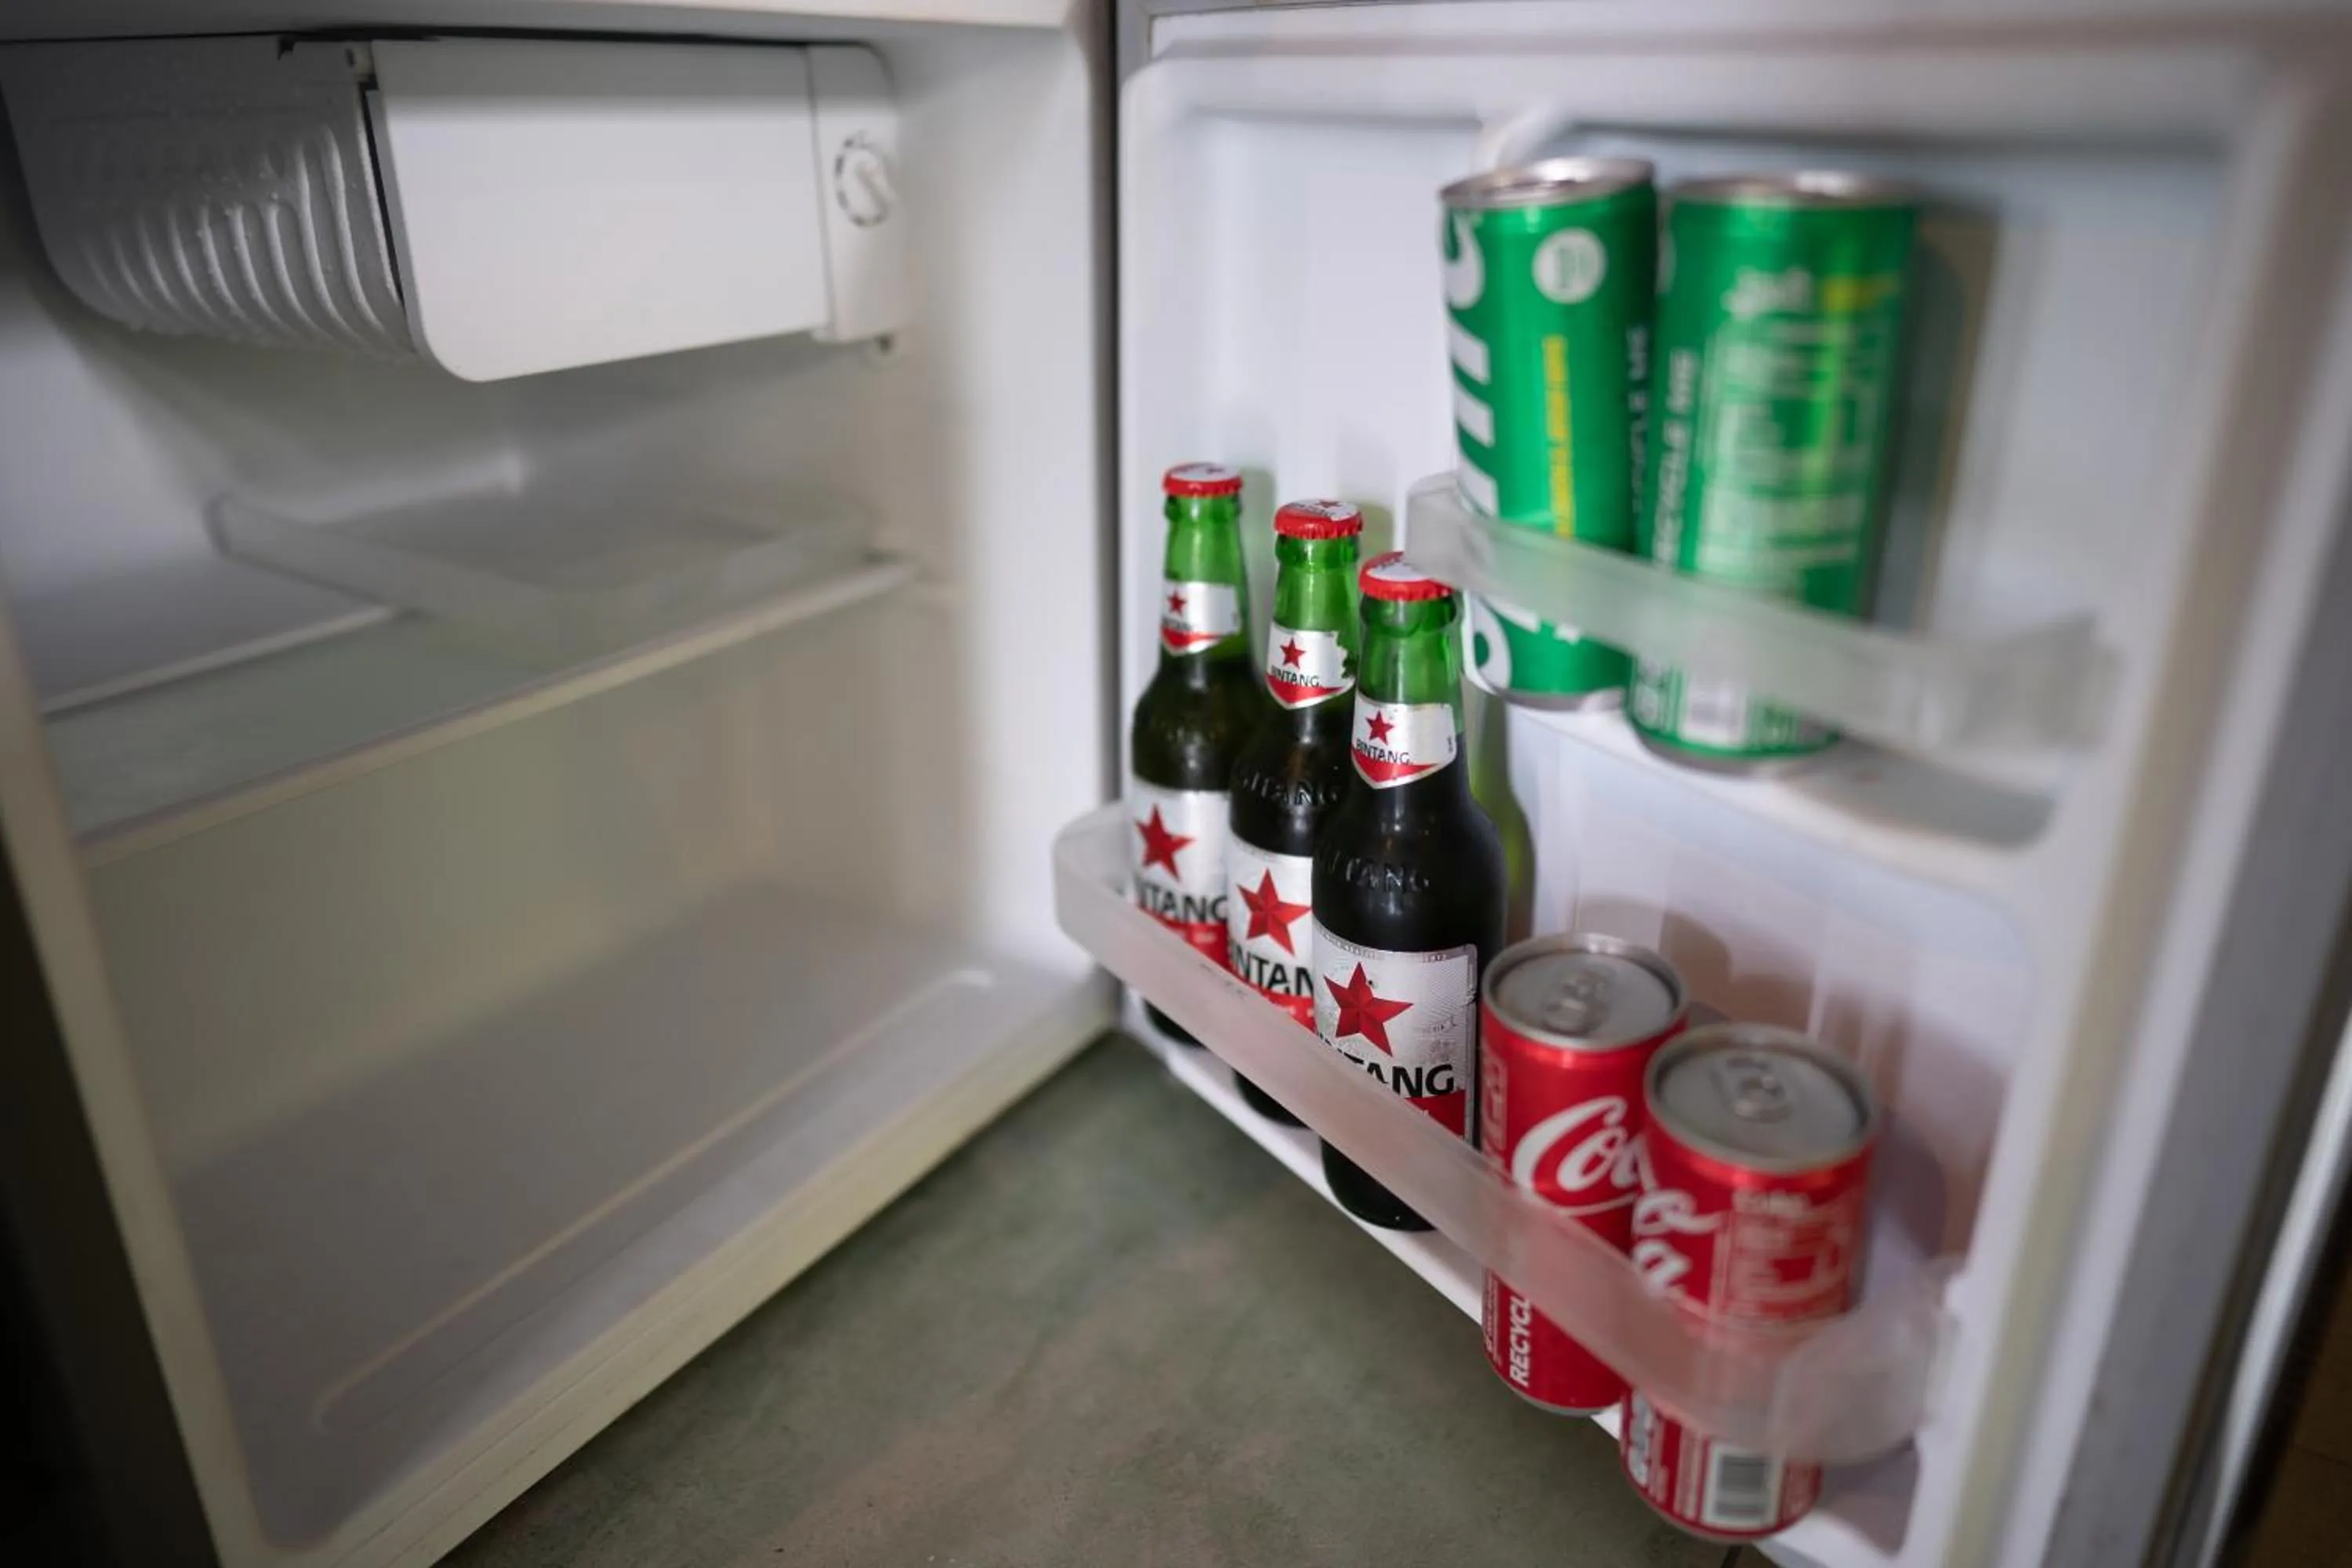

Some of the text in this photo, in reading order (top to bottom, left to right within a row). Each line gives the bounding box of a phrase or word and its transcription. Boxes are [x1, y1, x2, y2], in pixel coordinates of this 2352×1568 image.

[1271, 665, 1321, 688] BINTANG
[1356, 738, 1410, 764] BINTANG
[1235, 943, 1315, 998] NTAN
[1509, 1295, 1532, 1388] RECYCL
